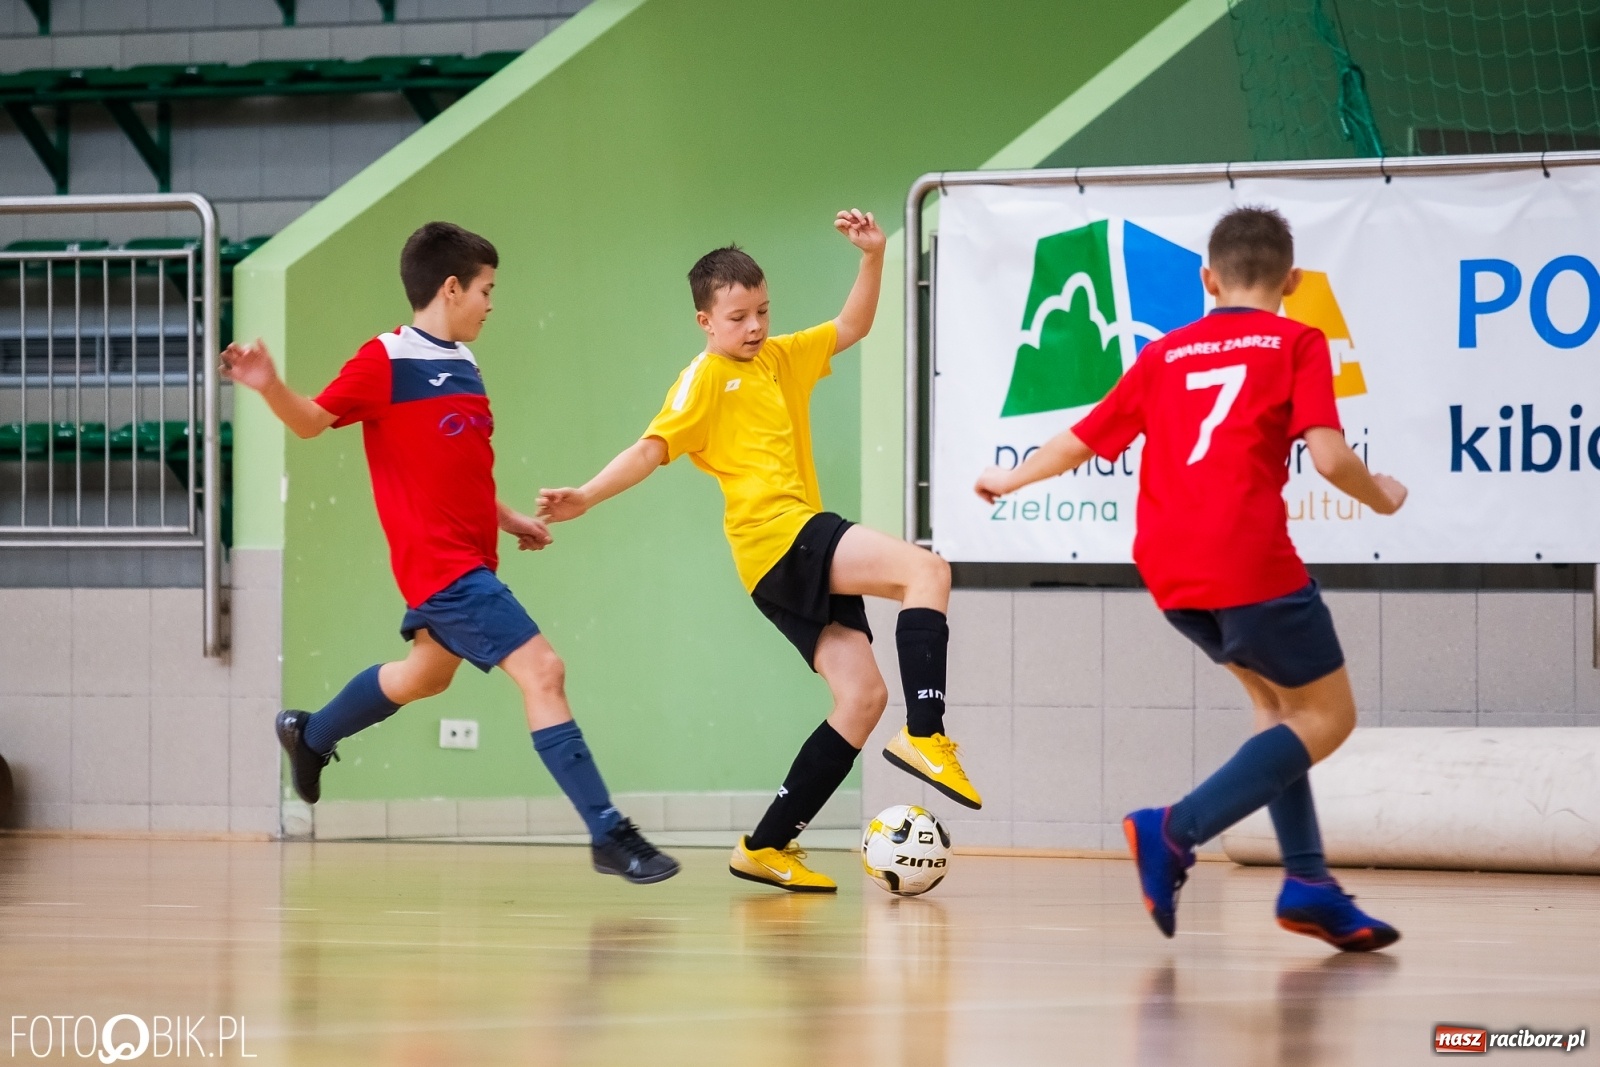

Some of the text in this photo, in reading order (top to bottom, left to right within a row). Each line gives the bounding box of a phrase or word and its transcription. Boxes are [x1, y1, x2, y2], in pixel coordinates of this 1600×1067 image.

[1459, 255, 1600, 349] PO
[1165, 335, 1282, 363] GWAREK ZABRZE
[1186, 364, 1247, 466] 7
[991, 491, 1361, 521] zielona ultur
